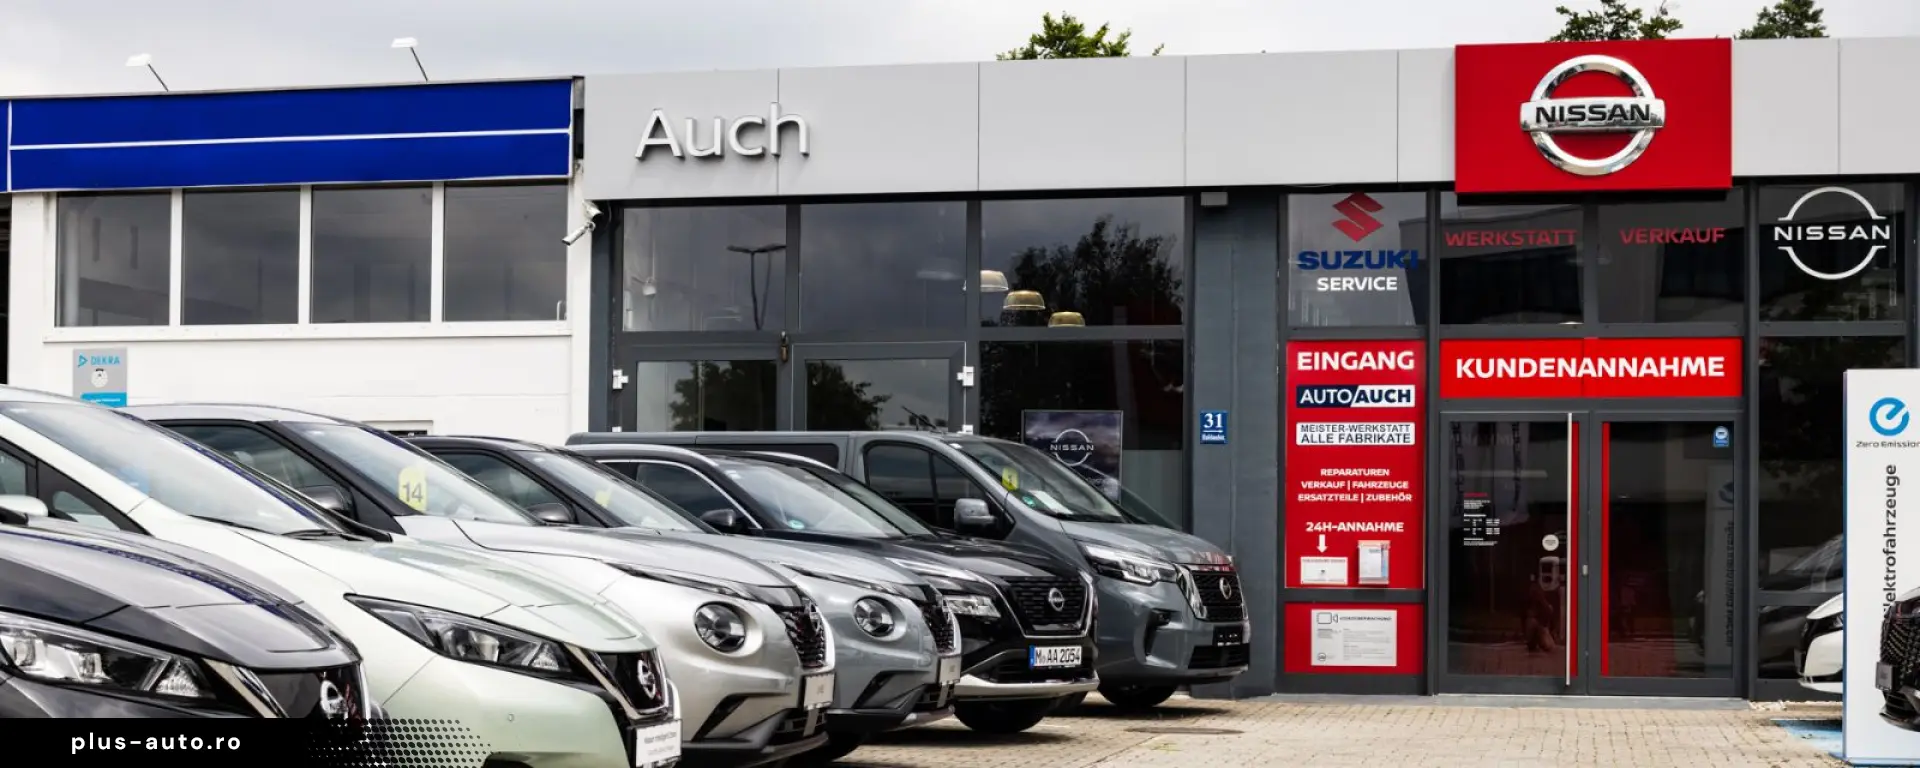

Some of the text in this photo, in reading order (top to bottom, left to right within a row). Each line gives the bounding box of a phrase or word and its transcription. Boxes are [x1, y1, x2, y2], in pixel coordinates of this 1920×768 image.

[1535, 104, 1651, 124] NISSAN
[634, 101, 809, 159] Auch
[1444, 230, 1578, 247] WERKSTATT
[1619, 227, 1725, 244] VERKAUF
[1774, 225, 1890, 241] NISSAN
[1296, 249, 1419, 270] SUZUKI
[1316, 276, 1398, 292] SERVICE
[1297, 350, 1415, 371] EINGANG
[1455, 356, 1726, 379] KUNDENANNAHME
[1203, 412, 1223, 429] 31
[1300, 424, 1411, 433] MEISTER-WERKSTATT
[1300, 433, 1411, 444] ALLE FABRIKATE
[1855, 440, 1880, 449] Zero
[1049, 443, 1095, 452] NISSAN
[1320, 468, 1390, 477] REPARATUREN
[402, 482, 424, 503] 14
[1301, 480, 1346, 489] VERKAUF
[1352, 480, 1409, 489] FAHRZEUGE
[1298, 493, 1359, 502] ERSATZTEILE
[1366, 492, 1413, 502] ZUBEHÖR
[1306, 521, 1405, 533] 24H-ANNAHME
[1882, 464, 1900, 618] lektrofahrzeuge
